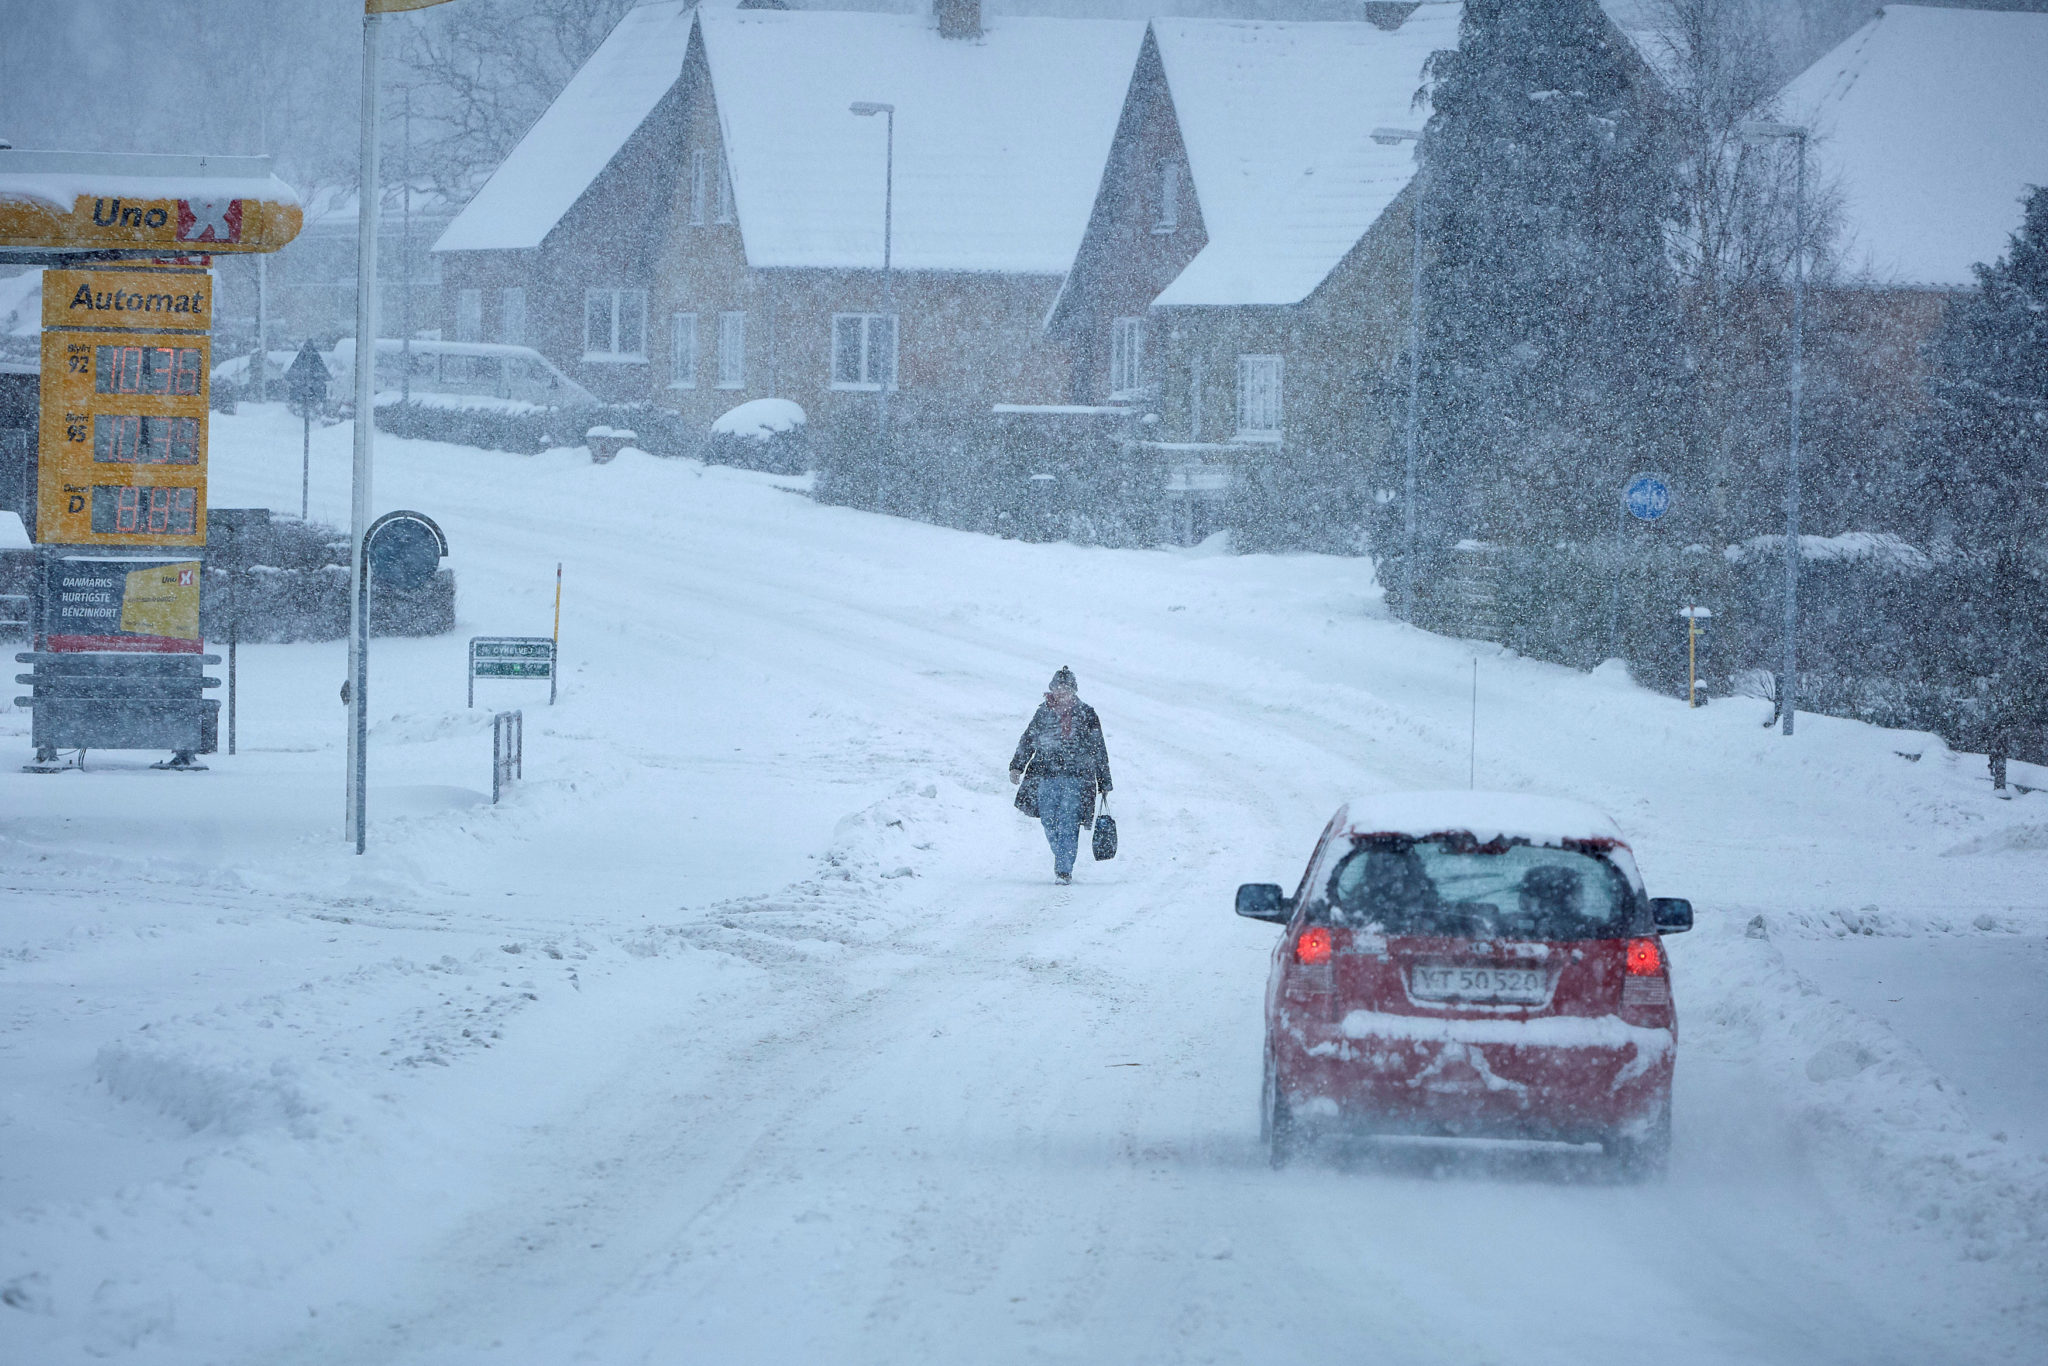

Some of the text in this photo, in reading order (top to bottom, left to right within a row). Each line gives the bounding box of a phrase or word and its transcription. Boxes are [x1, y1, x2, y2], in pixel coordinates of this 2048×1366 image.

[92, 198, 169, 229] Uno
[69, 283, 205, 314] Automat
[69, 355, 89, 373] 92
[67, 425, 88, 443] 95
[68, 495, 86, 514] D
[62, 577, 113, 588] DANMARKS
[62, 592, 111, 603] HURTIGSTE
[61, 607, 118, 618] BENZINKORT
